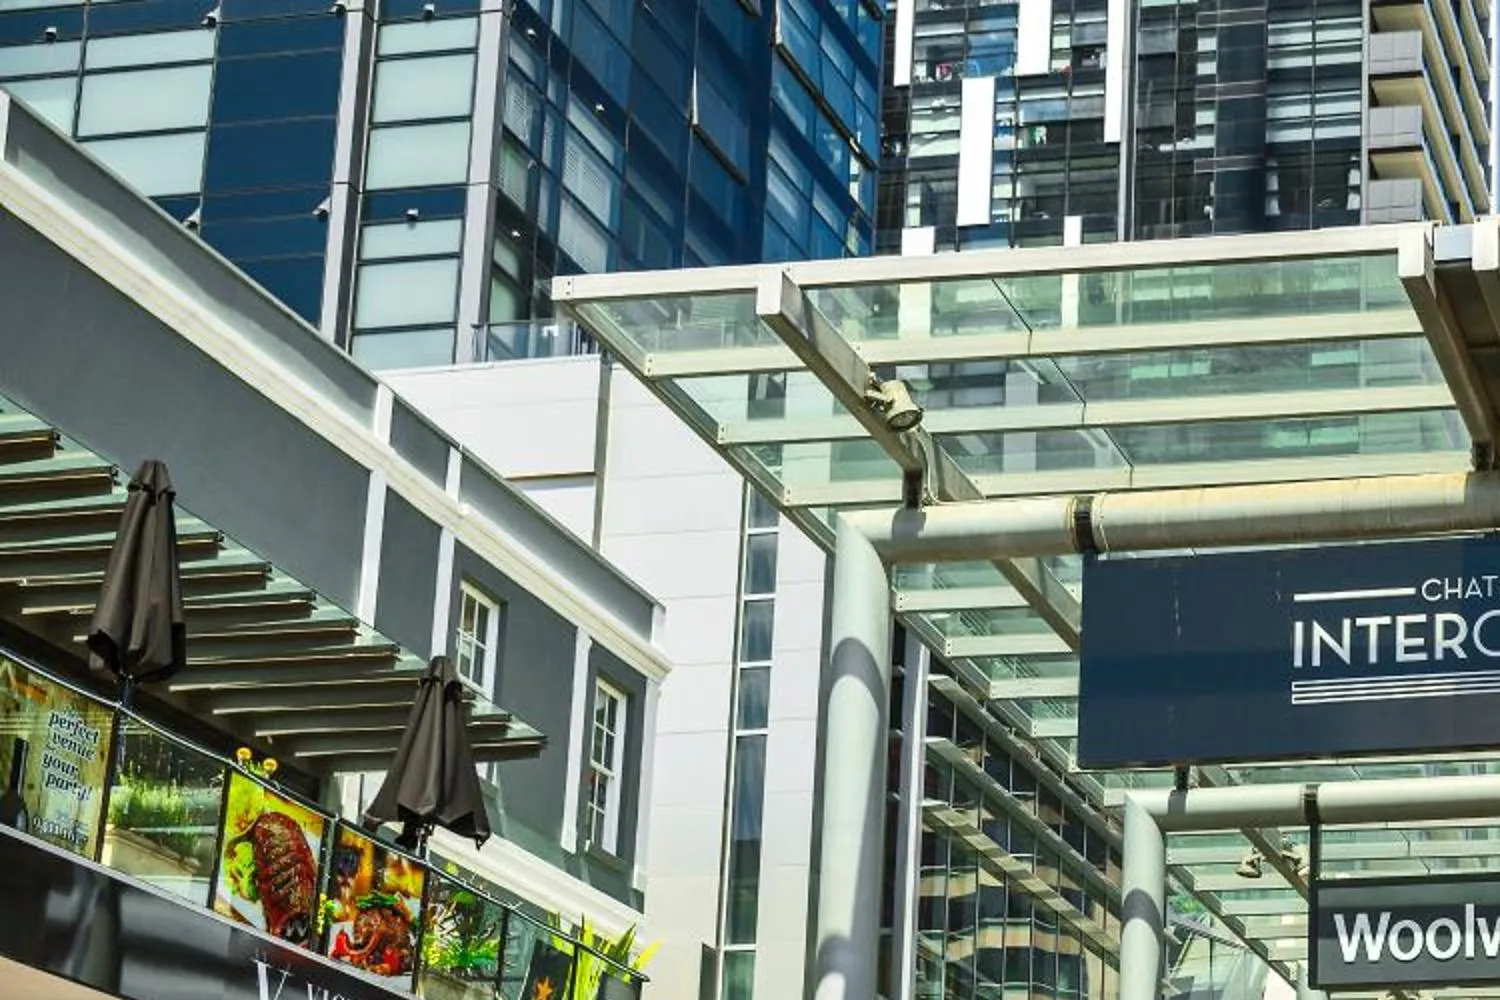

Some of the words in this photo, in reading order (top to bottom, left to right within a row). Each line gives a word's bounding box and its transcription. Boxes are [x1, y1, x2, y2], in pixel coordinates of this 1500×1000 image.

[49, 711, 99, 745] perfect
[52, 731, 96, 761] venue
[42, 752, 79, 777] your
